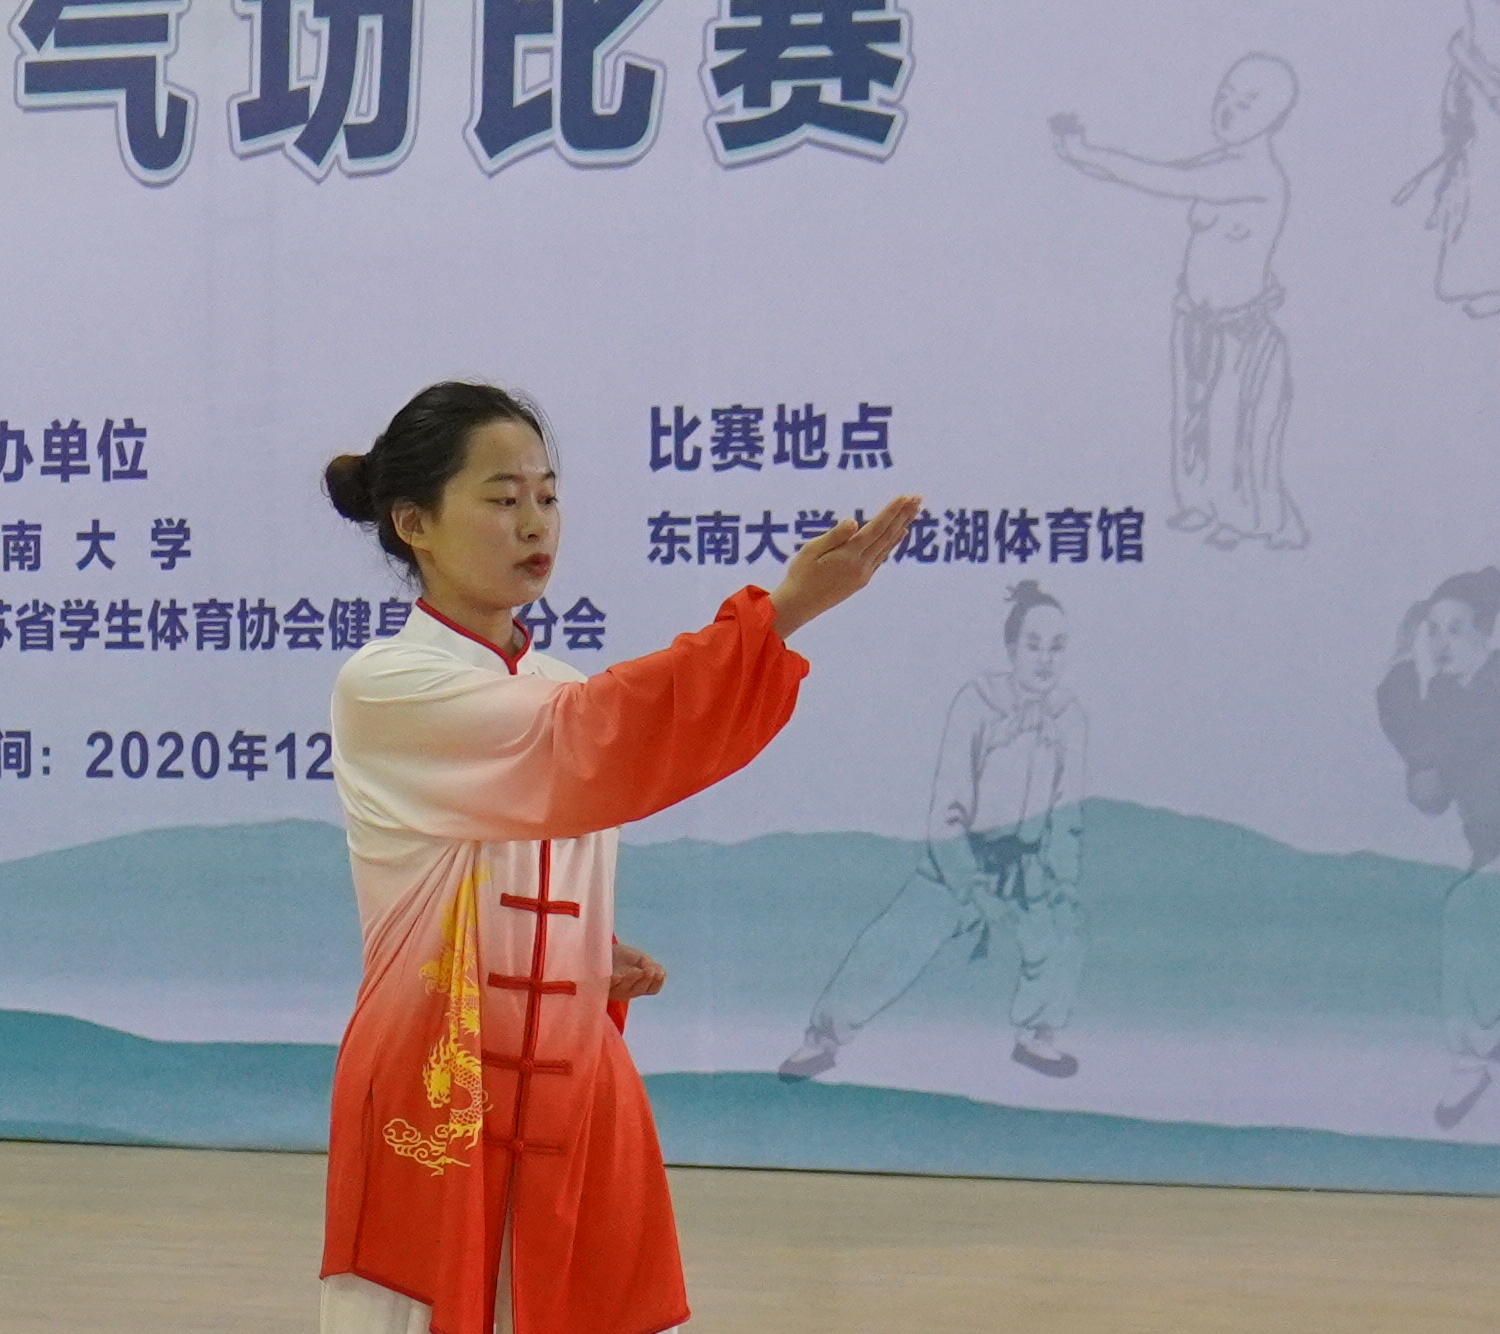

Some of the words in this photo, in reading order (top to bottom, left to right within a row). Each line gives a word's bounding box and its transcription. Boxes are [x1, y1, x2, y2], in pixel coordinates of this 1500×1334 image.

[647, 401, 895, 473] 比赛地点
[646, 506, 1145, 565] 东南大学龙湖体育馆
